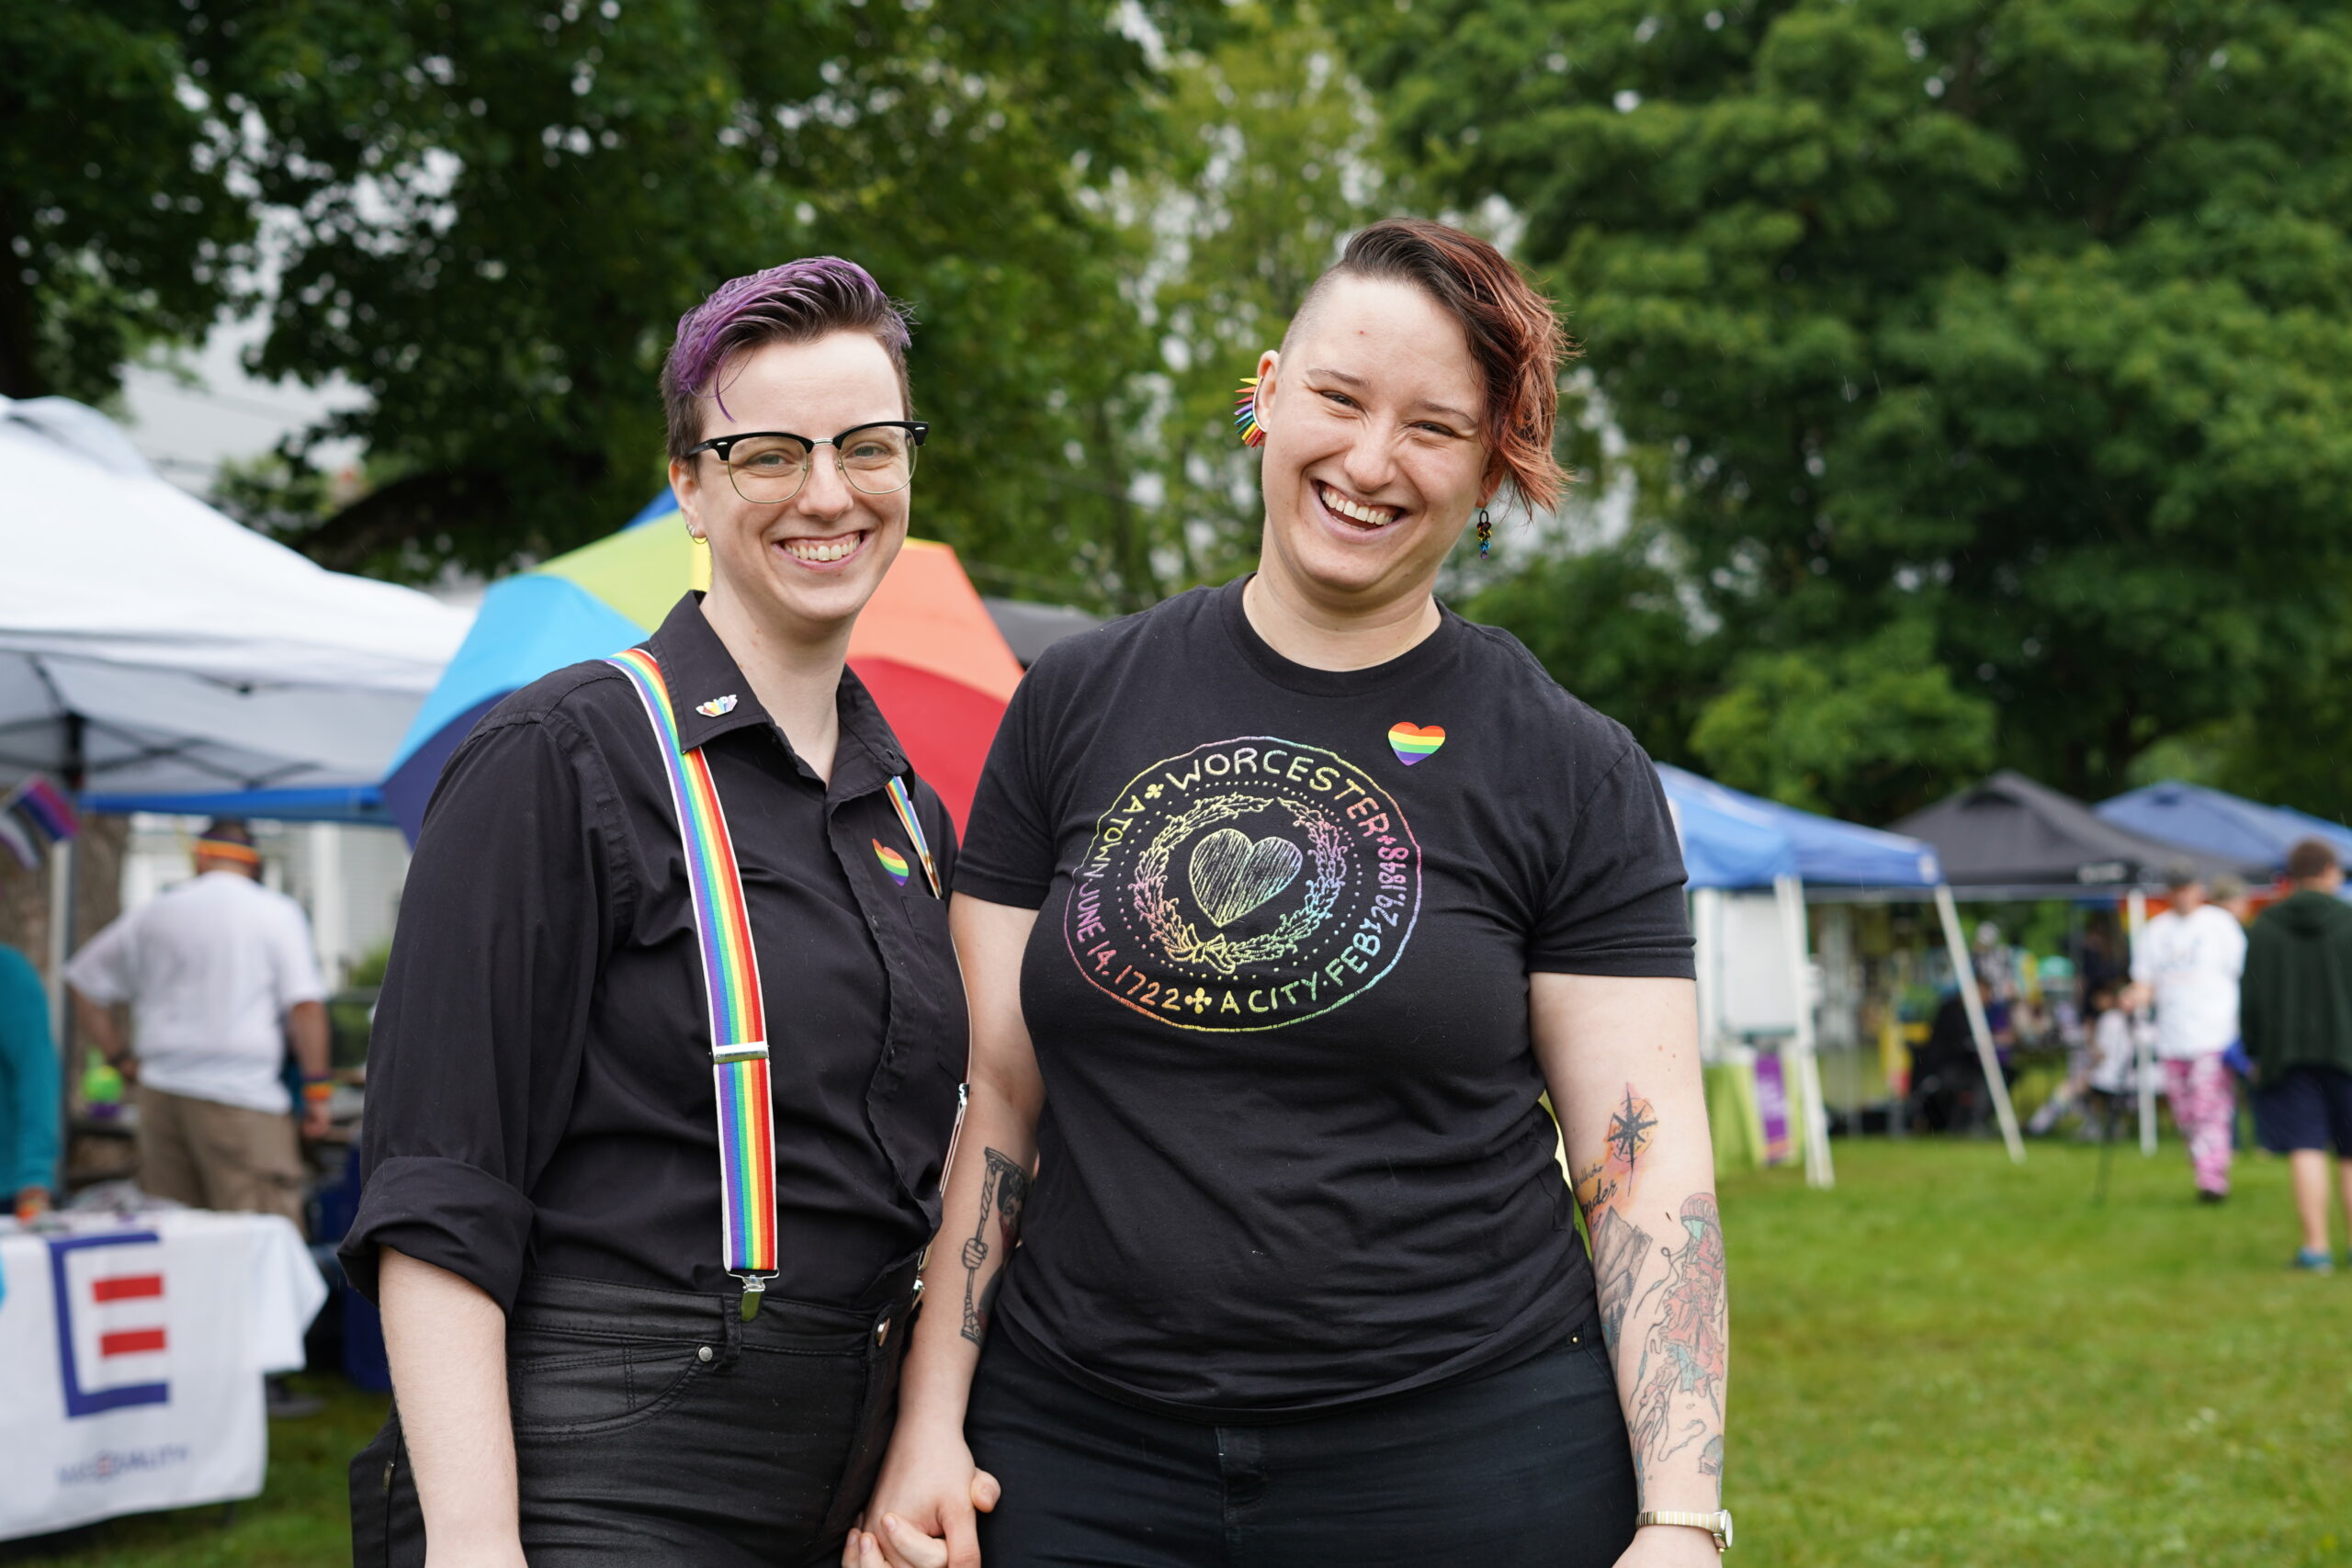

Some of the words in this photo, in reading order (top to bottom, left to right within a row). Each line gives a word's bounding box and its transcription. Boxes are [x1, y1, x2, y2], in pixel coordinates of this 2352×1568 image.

[1122, 795, 1147, 814] A
[1164, 747, 1390, 837] WORCESTER
[1082, 817, 1135, 879] TOWN
[1076, 882, 1106, 943] JUNE
[1114, 964, 1182, 1011] 1722
[1220, 989, 1241, 1014] A
[1248, 971, 1318, 1013] CITY
